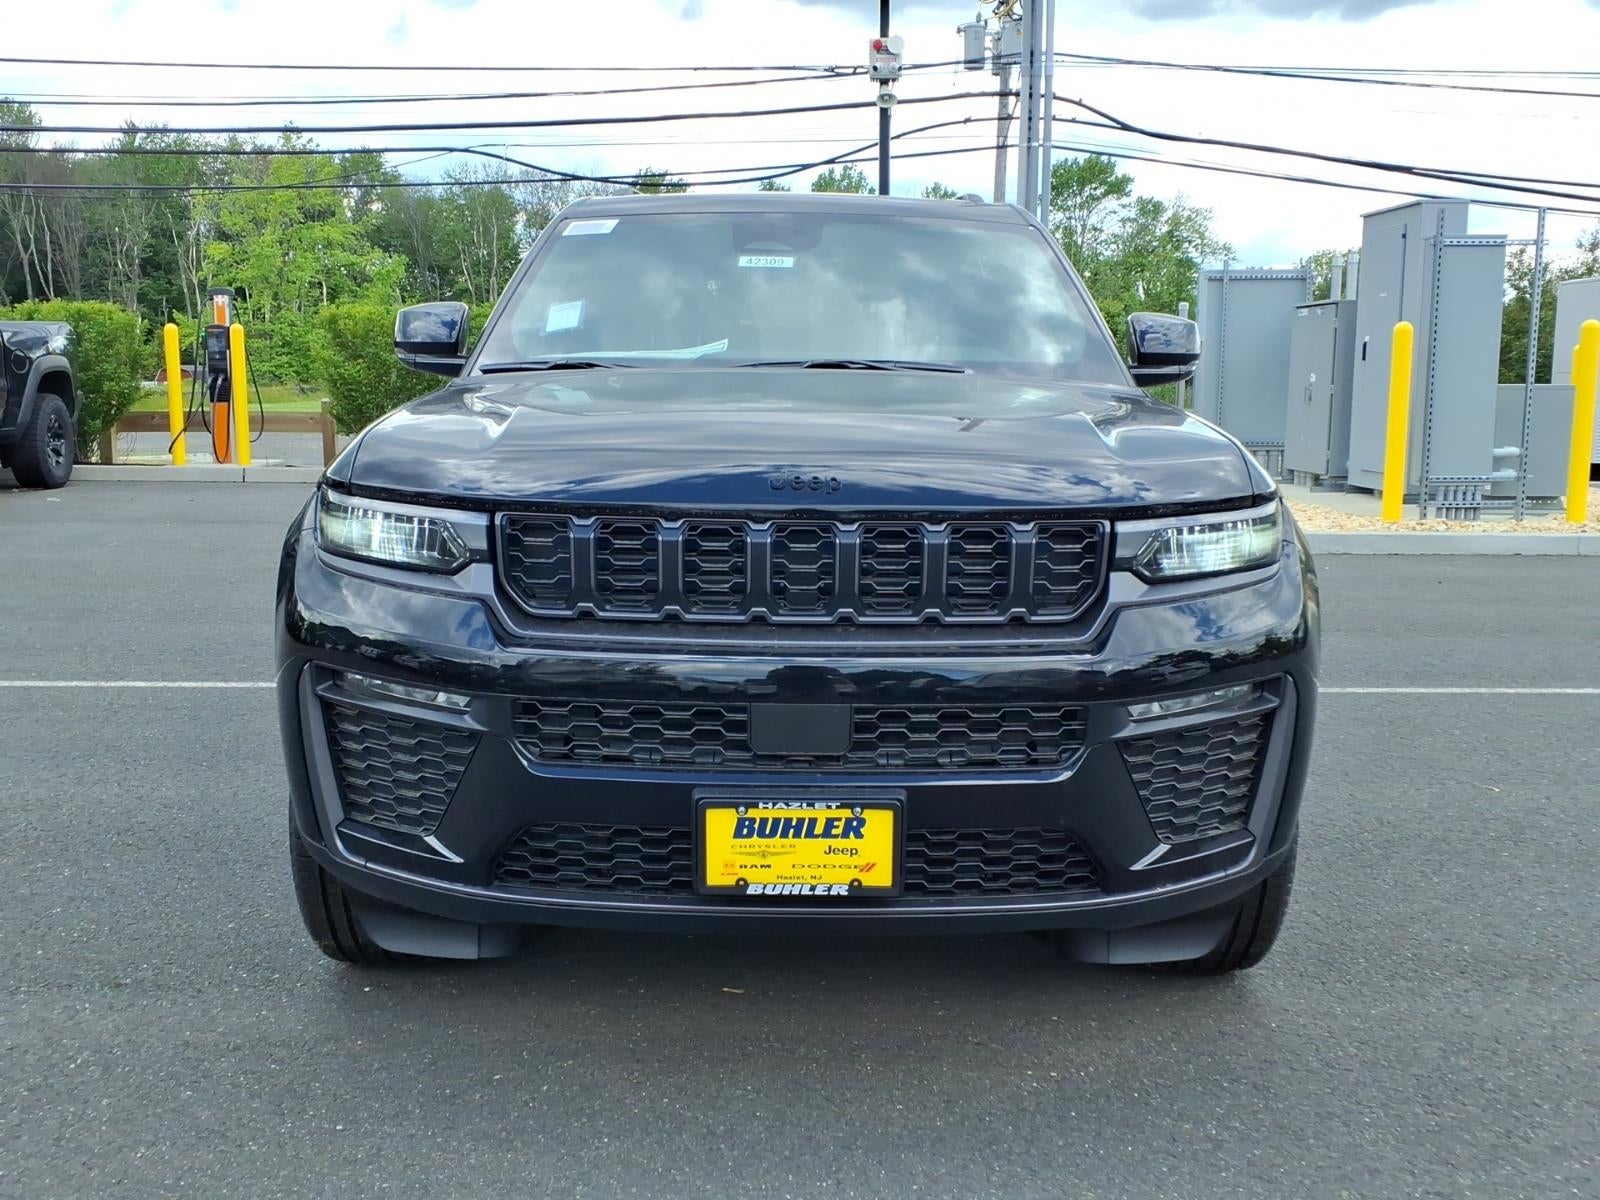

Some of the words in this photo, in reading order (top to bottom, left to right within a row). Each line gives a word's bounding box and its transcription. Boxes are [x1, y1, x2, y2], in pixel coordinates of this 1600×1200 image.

[746, 257, 785, 266] 42309
[768, 470, 842, 495] Jeep
[758, 802, 841, 810] HAZLET
[733, 815, 867, 840] BUHLER
[823, 844, 859, 858] Jeep
[746, 883, 849, 895] BUHLER
